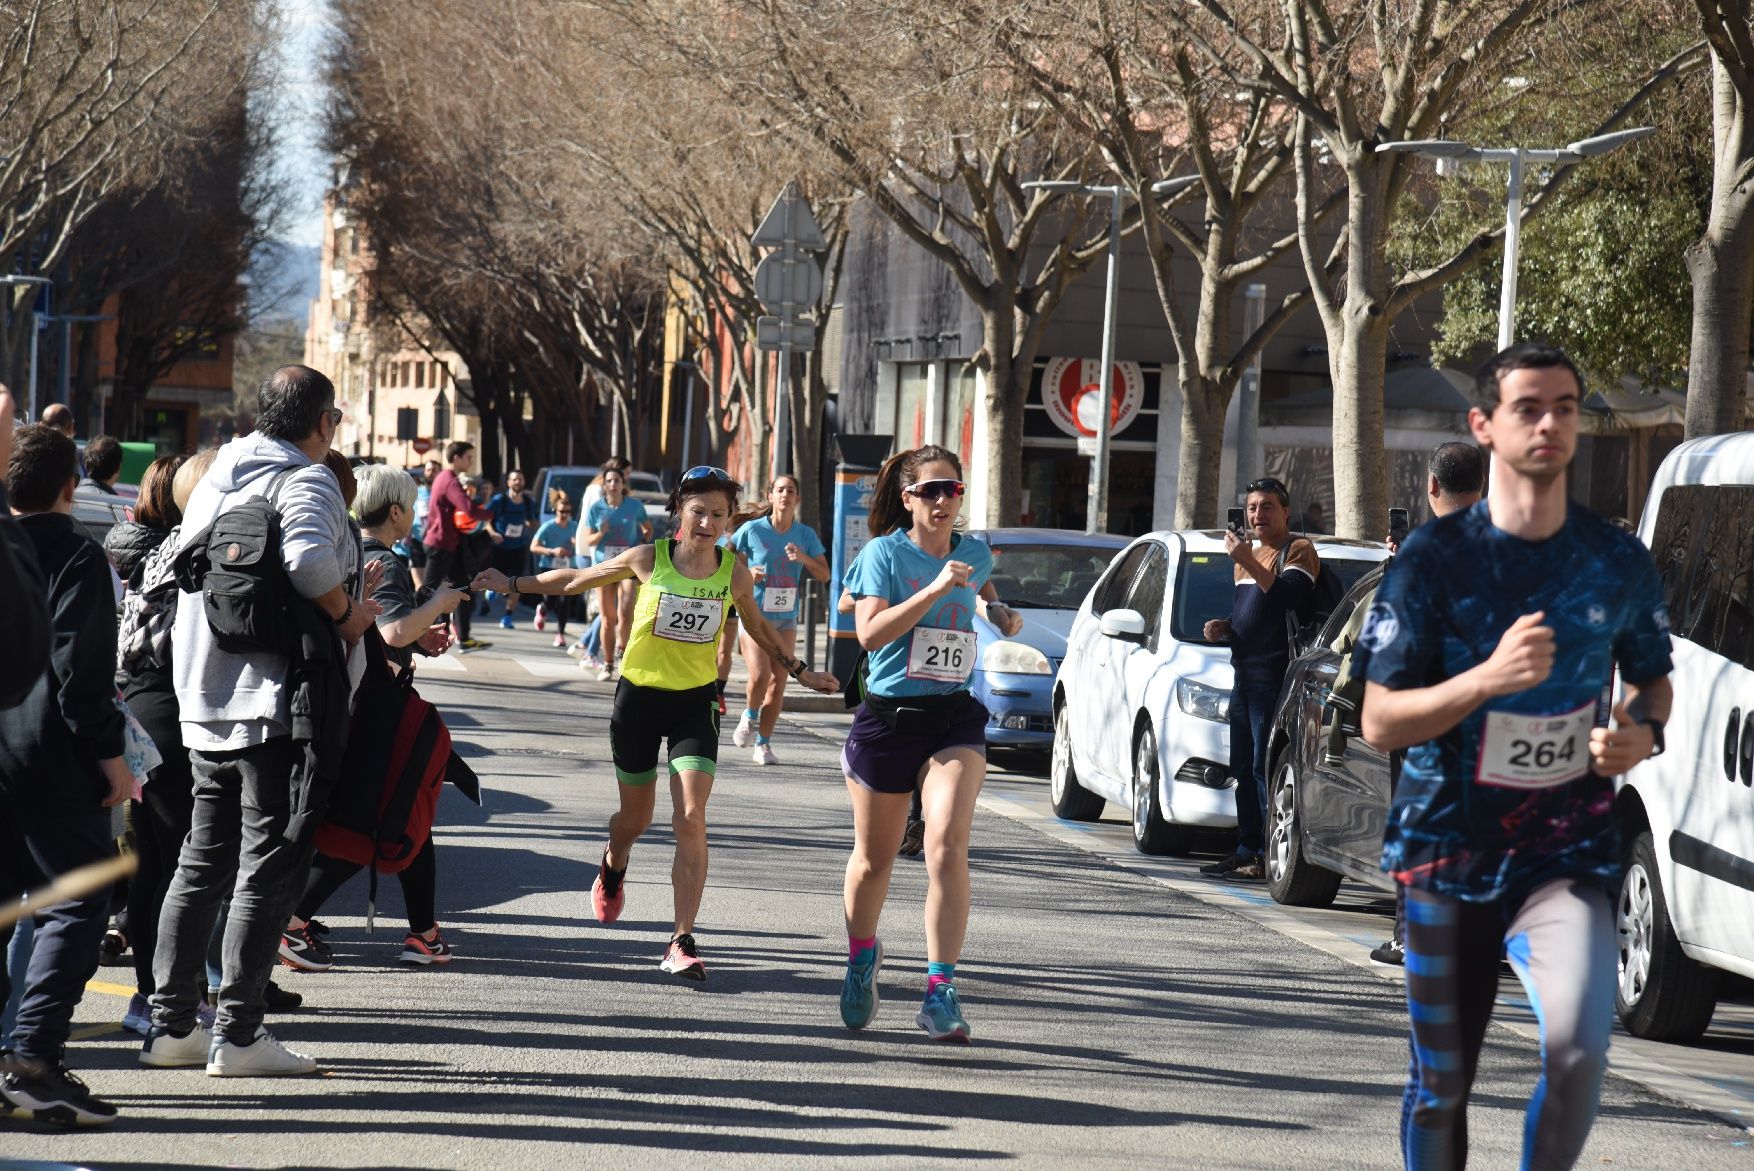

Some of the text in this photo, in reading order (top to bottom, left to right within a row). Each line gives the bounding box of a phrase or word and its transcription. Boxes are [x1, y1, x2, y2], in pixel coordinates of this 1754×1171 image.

[775, 596, 787, 606] 25
[669, 611, 710, 631] 297
[925, 645, 963, 668] 216
[1508, 735, 1575, 768] 264
